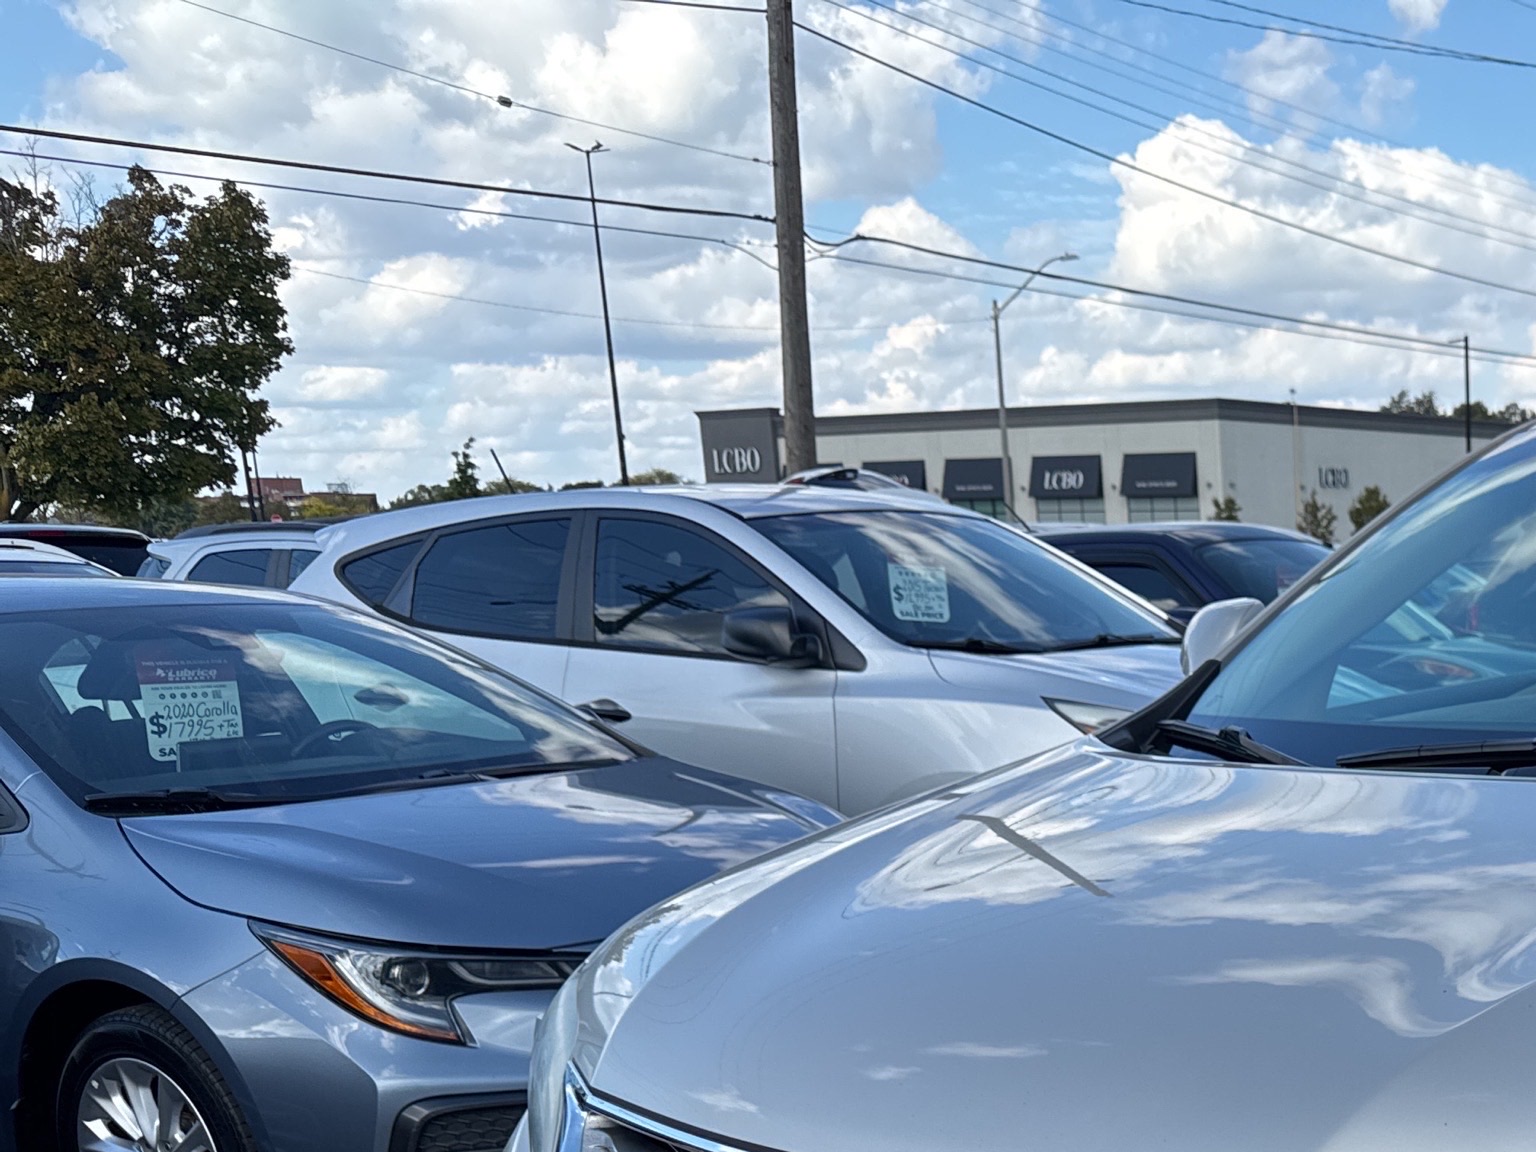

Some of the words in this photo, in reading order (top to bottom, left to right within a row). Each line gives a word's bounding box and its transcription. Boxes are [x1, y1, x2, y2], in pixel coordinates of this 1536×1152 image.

[712, 446, 761, 474] LCBO
[1043, 469, 1084, 490] LCBO
[1318, 467, 1350, 489] LCBO
[163, 703, 195, 720] 2020
[196, 701, 238, 718] Corolla
